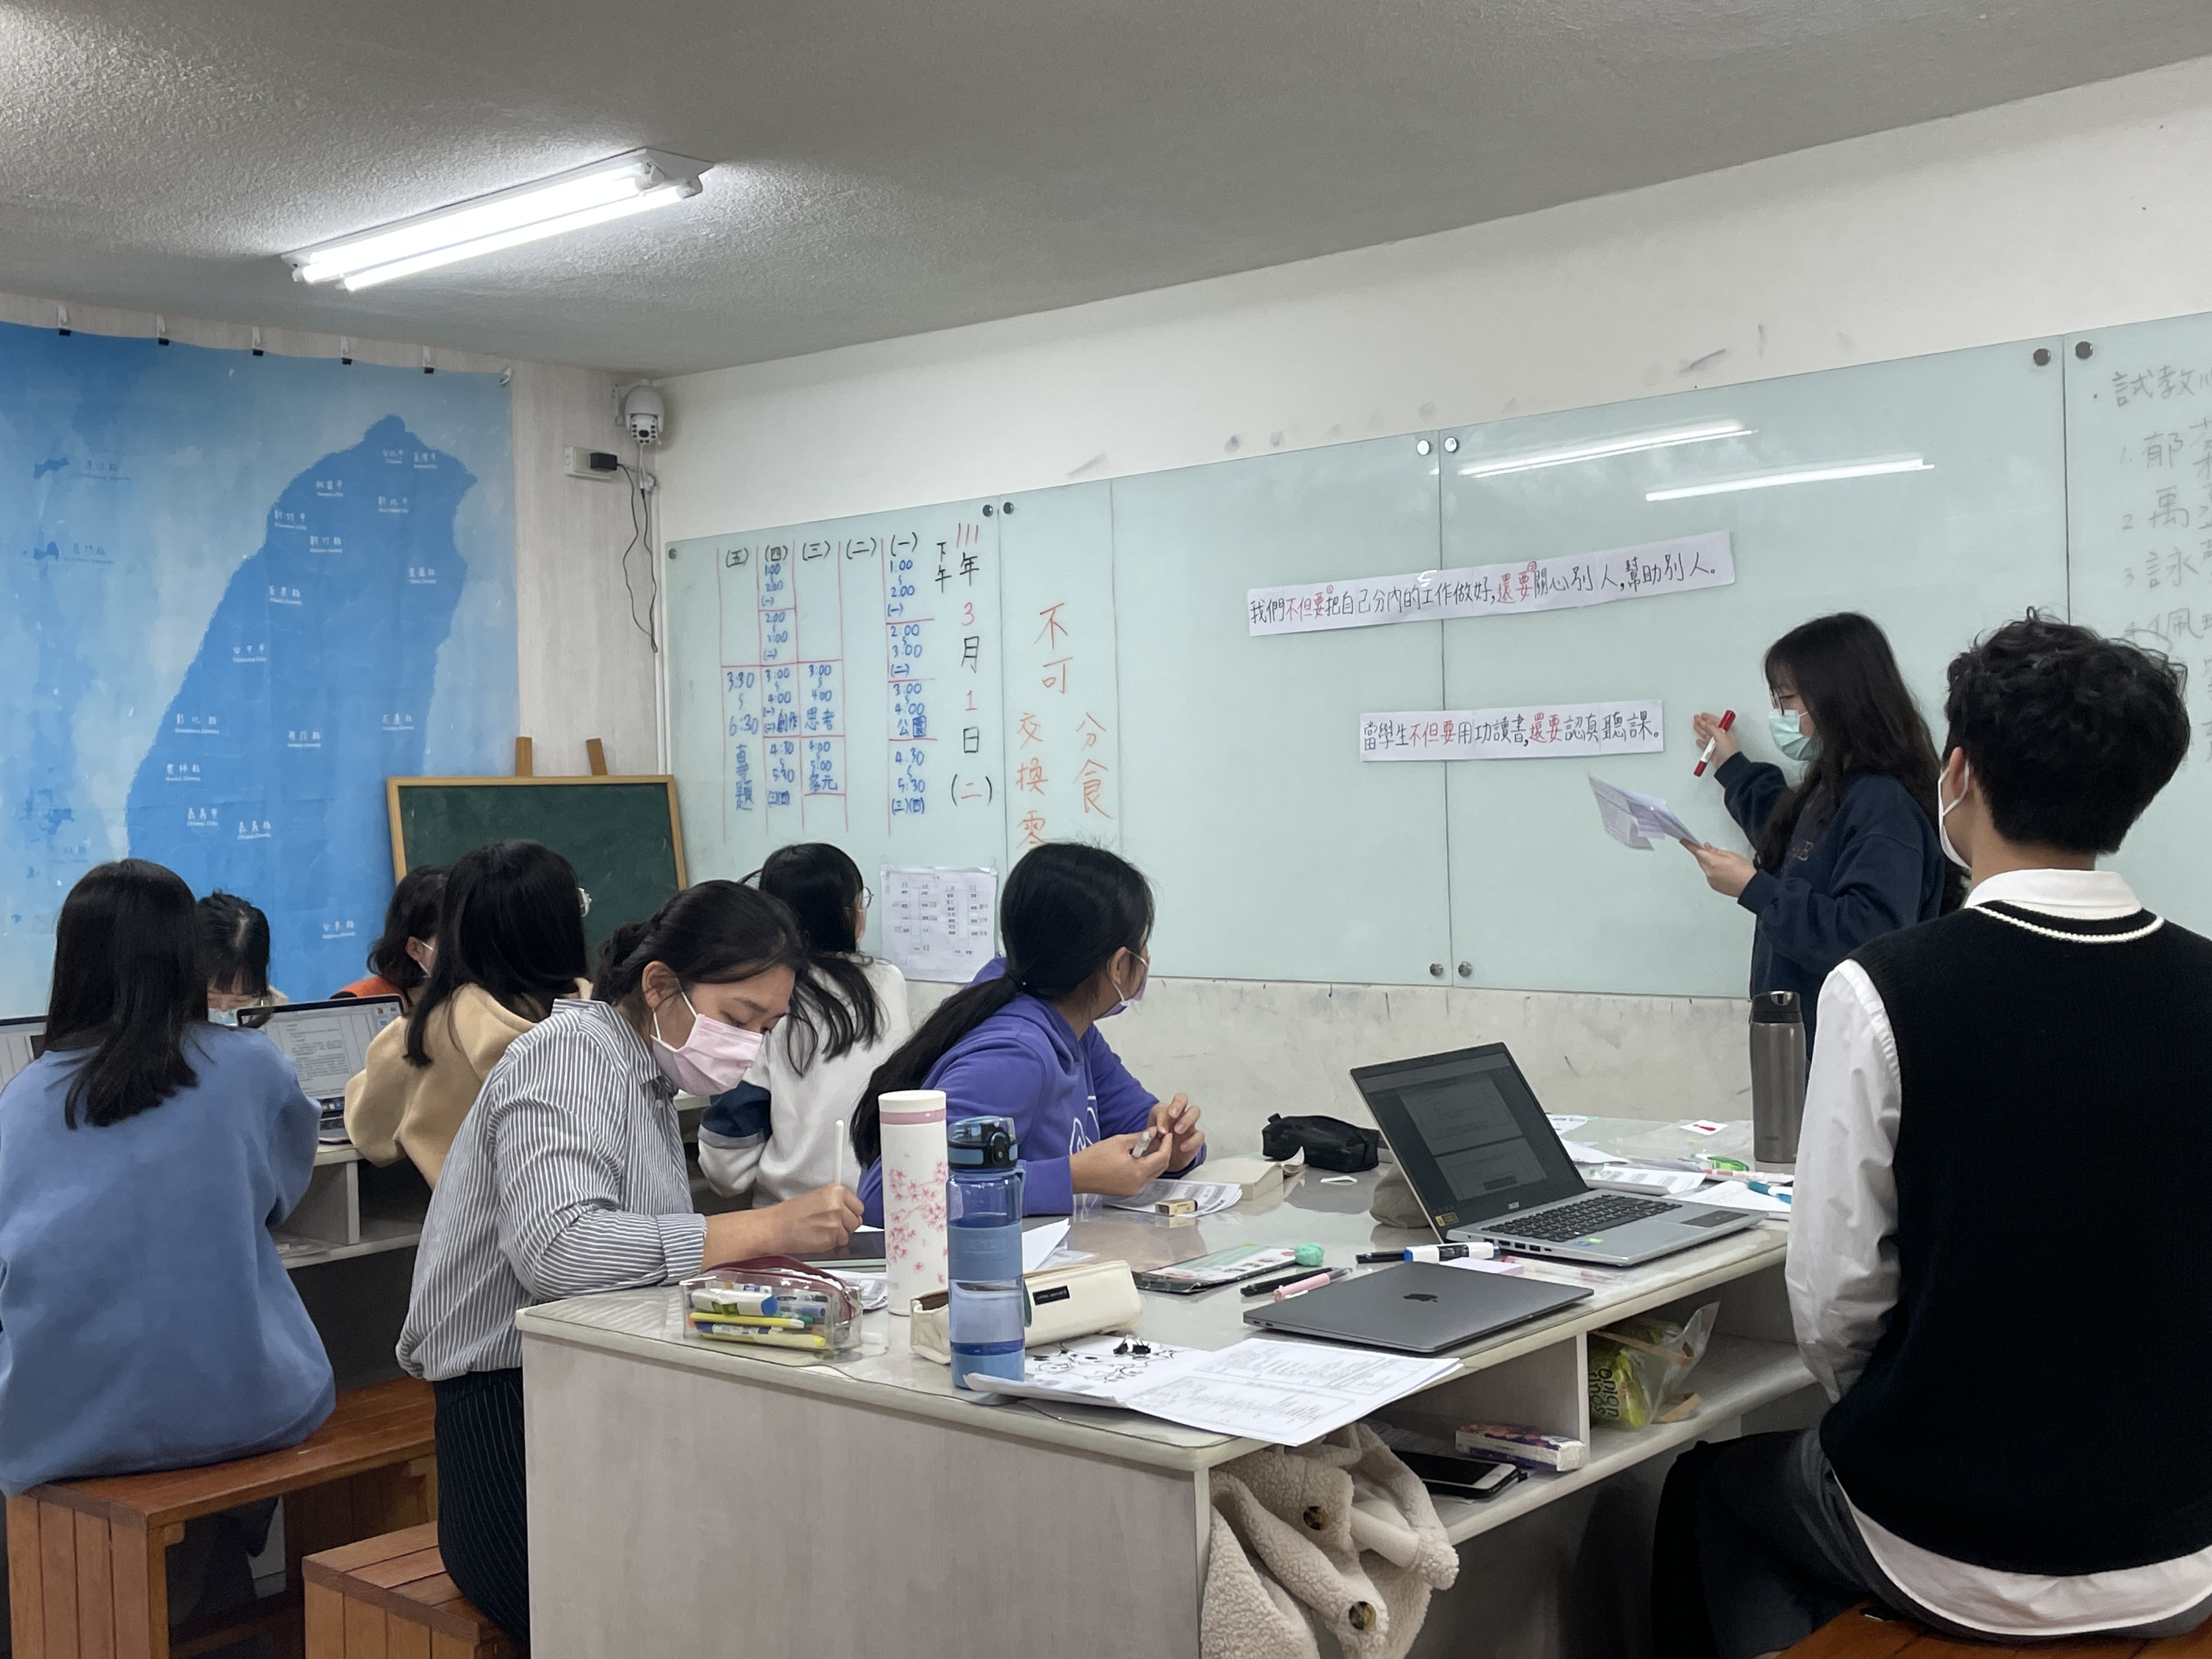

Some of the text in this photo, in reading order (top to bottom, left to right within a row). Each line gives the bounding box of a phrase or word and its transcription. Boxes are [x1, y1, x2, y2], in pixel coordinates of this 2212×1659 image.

[935, 542, 952, 594] 下午
[1034, 602, 1073, 694] 不可
[1073, 712, 1114, 819] 分食
[1598, 1367, 1620, 1417] onion
